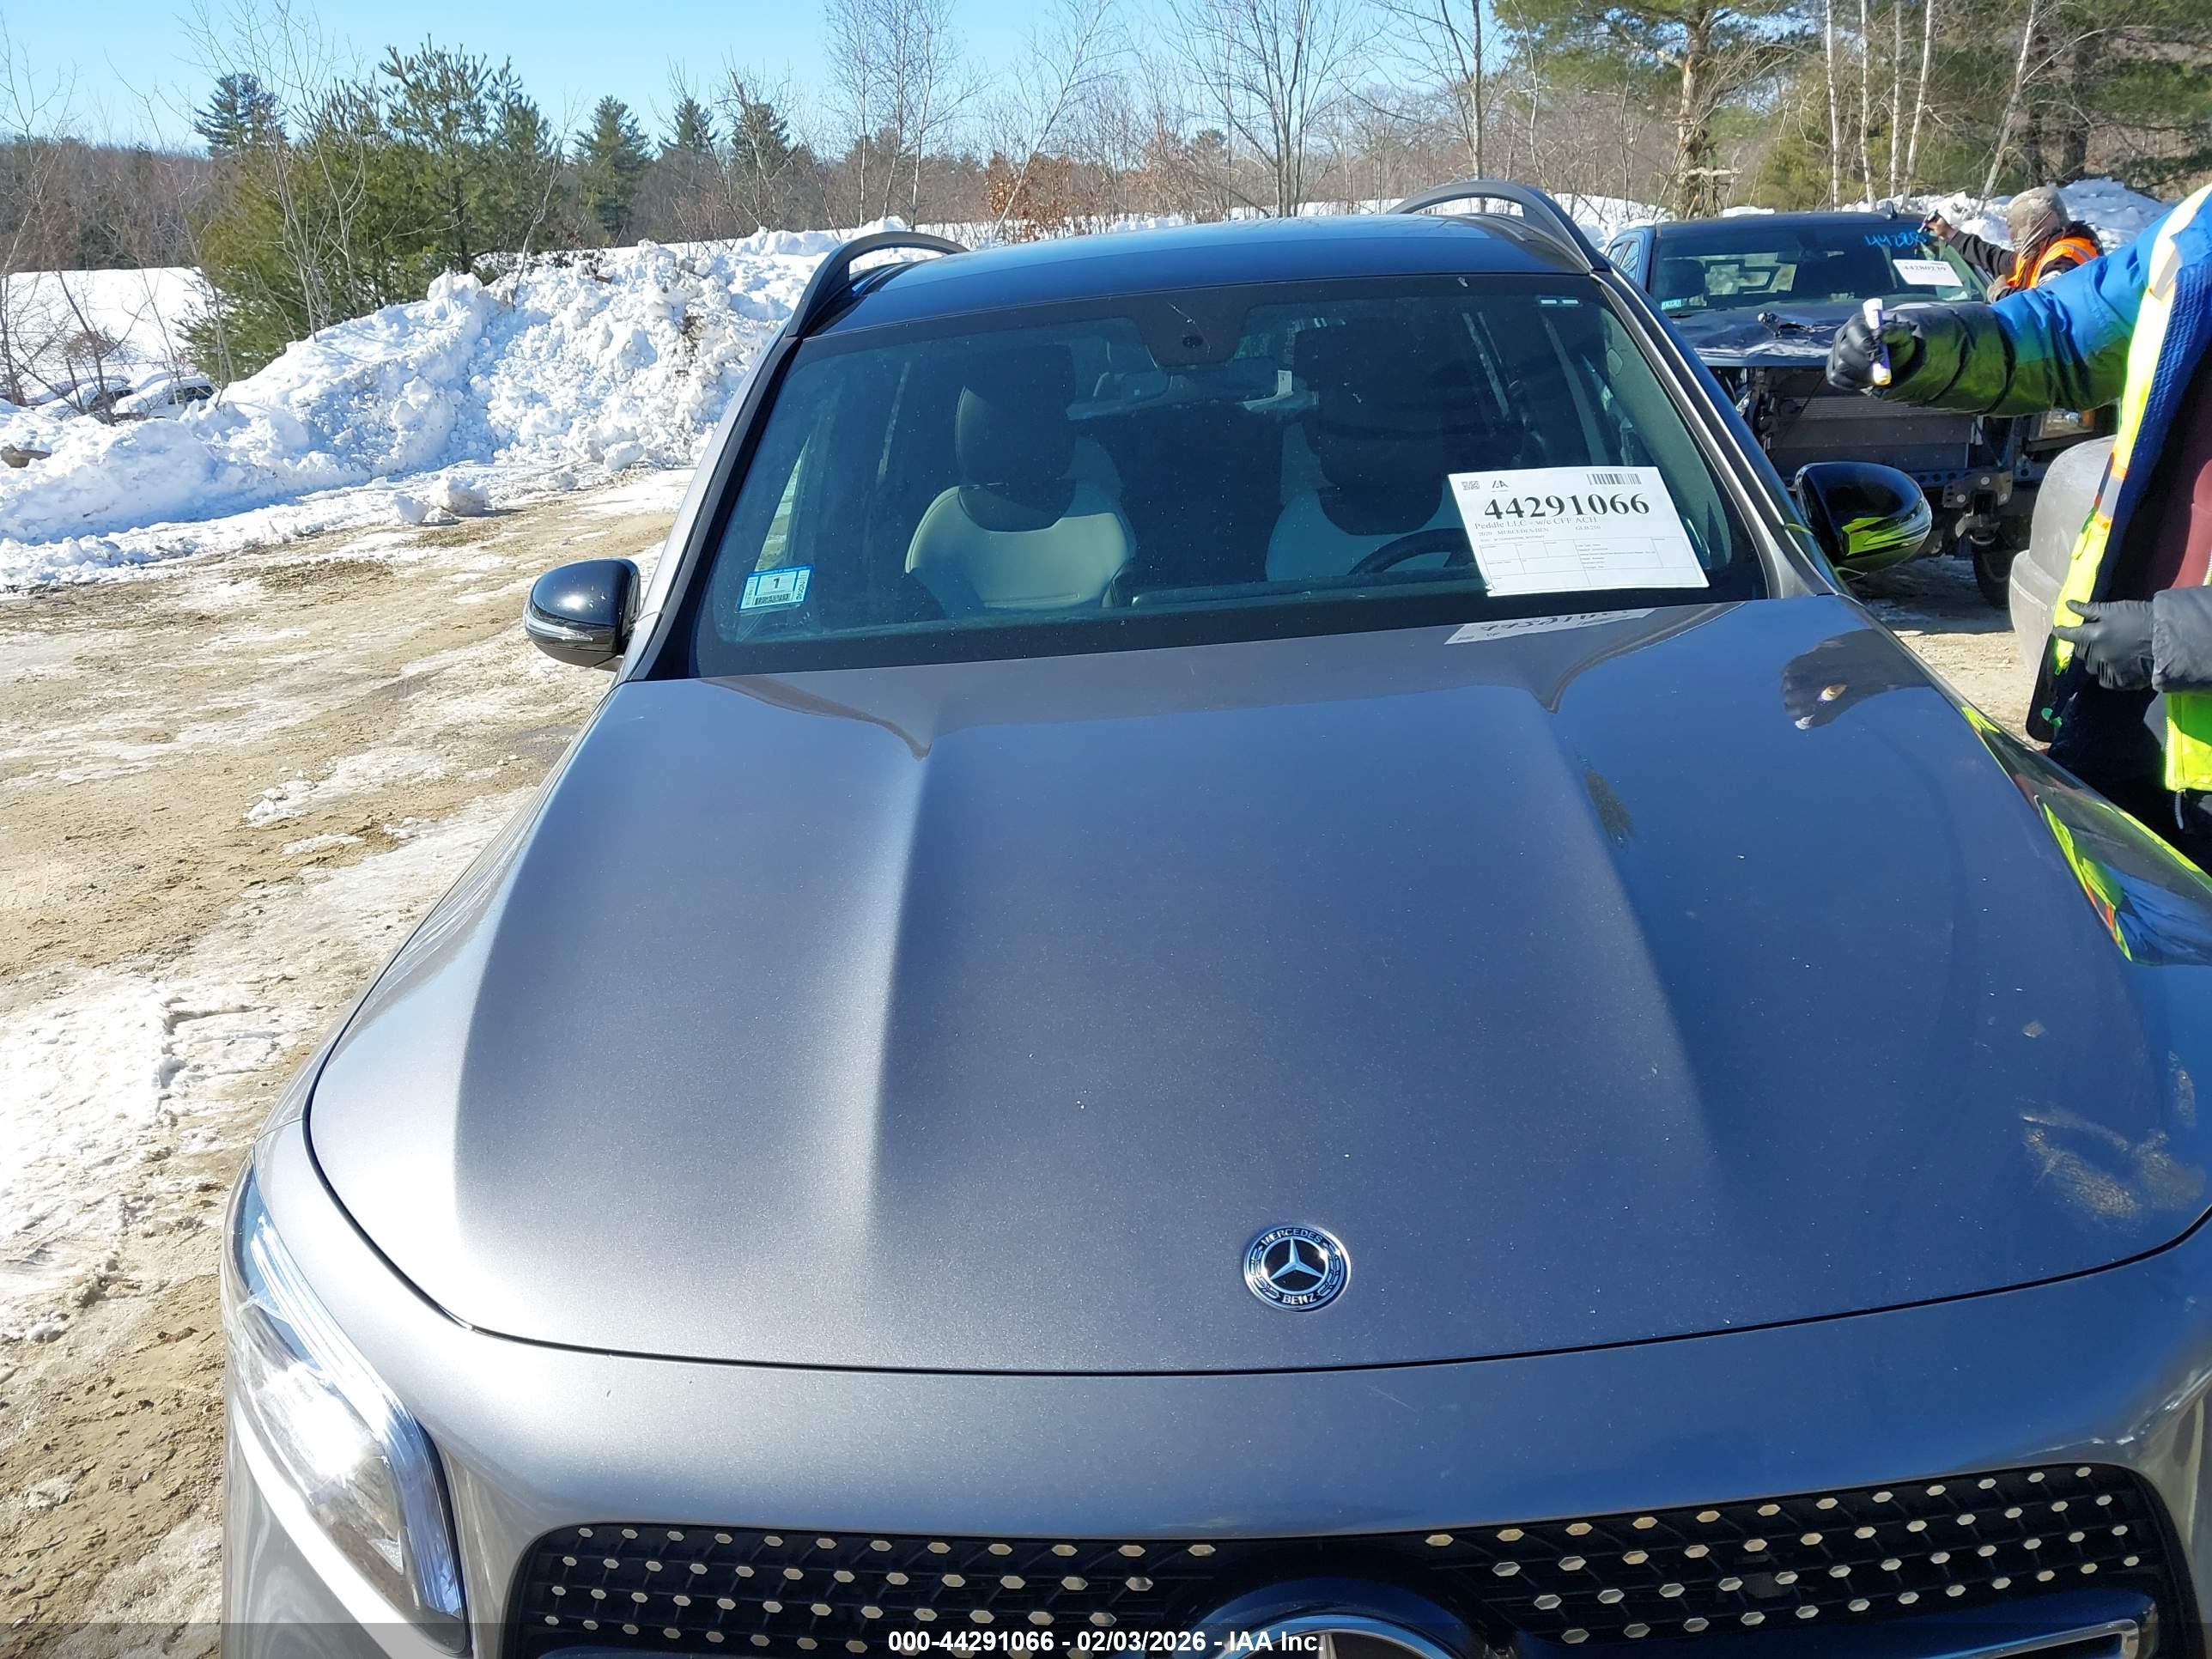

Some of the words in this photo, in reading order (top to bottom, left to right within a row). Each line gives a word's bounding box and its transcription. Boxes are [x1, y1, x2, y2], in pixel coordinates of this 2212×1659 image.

[1484, 493, 1650, 520] 44291066
[1474, 521, 1504, 530] Peddle
[1507, 518, 1527, 528] LLC
[1575, 515, 1597, 524] ACH
[1261, 1228, 1322, 1246] MERCEDES
[1282, 1294, 1317, 1305] BENZ
